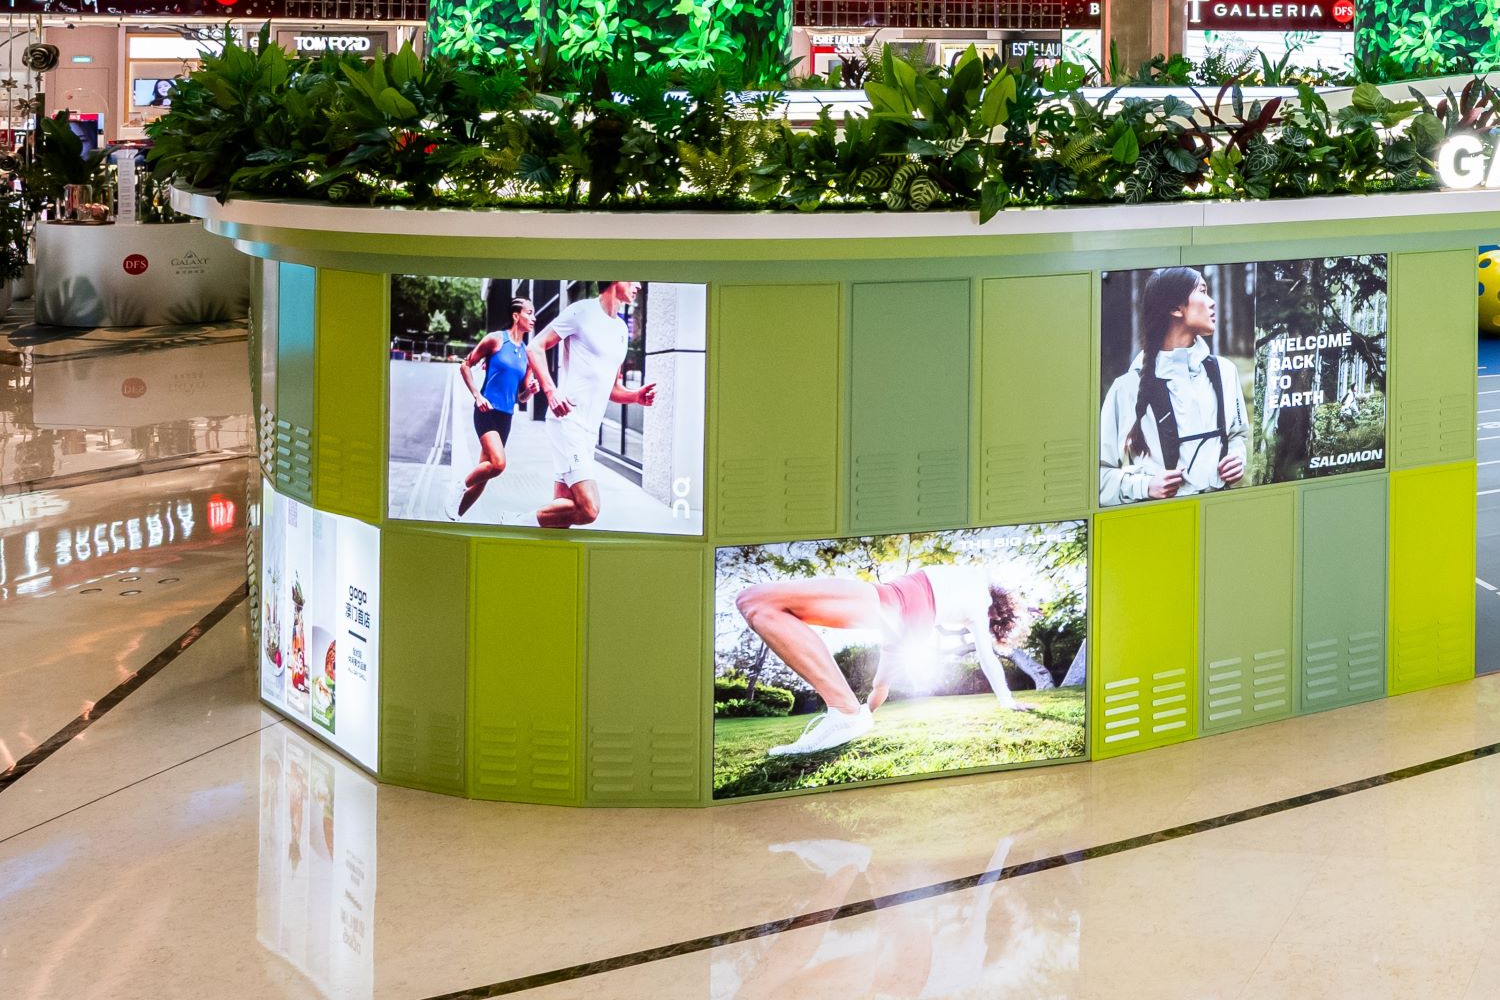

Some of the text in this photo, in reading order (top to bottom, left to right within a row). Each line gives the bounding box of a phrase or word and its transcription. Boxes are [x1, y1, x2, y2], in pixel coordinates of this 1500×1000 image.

[1214, 4, 1322, 17] GALLERIA
[1334, 5, 1353, 16] DFS
[294, 36, 326, 51] TOM
[125, 260, 147, 269] DFS
[1271, 332, 1352, 353] WELCOME
[1269, 354, 1315, 372] BACK
[1270, 375, 1292, 390] TO
[1269, 390, 1324, 409] EARTH
[1309, 449, 1383, 469] SALOMON
[960, 533, 1077, 550] THE BIG APPLE
